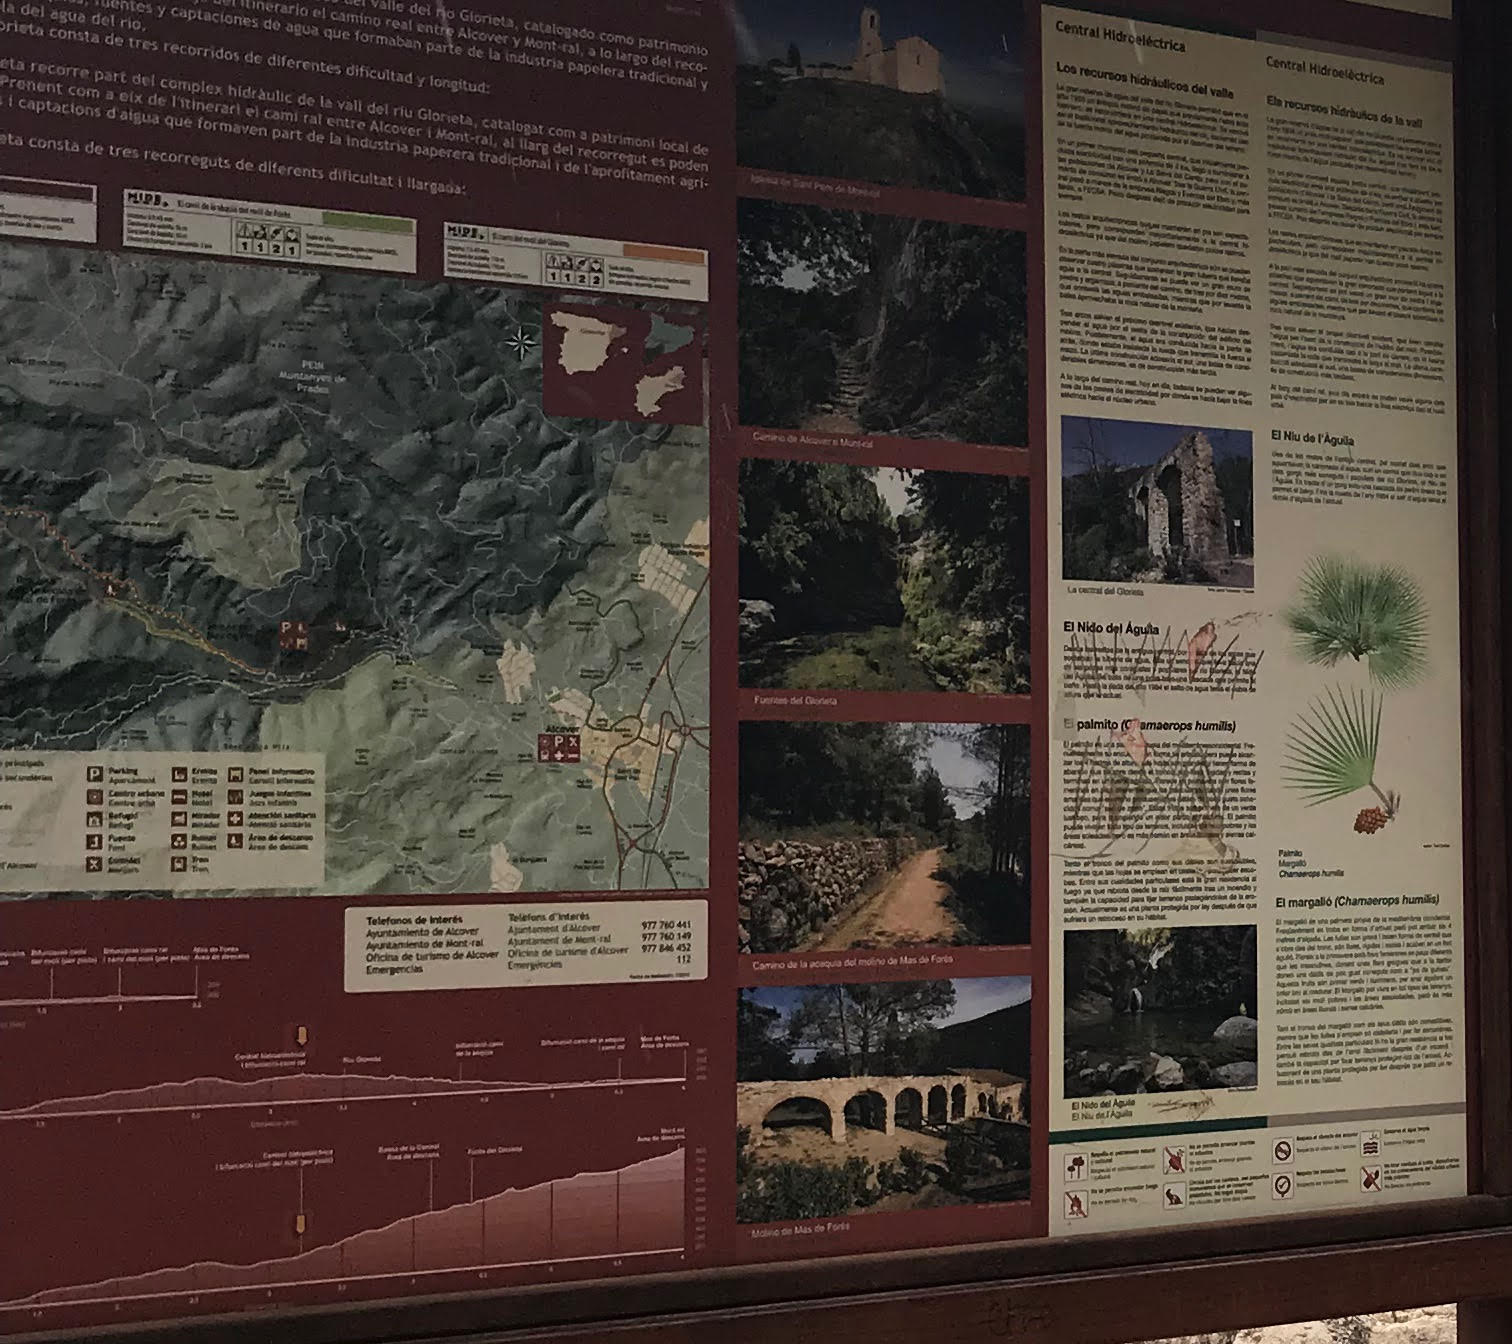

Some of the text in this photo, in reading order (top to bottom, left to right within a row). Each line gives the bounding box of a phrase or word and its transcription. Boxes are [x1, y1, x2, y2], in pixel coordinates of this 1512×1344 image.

[410, 1, 430, 16] del
[460, 9, 516, 31] Glorieta,
[524, 21, 594, 41] catalogado
[600, 32, 633, 46] como
[639, 38, 707, 57] patrimonio
[313, 6, 325, 18] el
[330, 10, 380, 26] camino
[386, 18, 411, 31] real
[417, 22, 453, 36] entre
[458, 25, 507, 44] Alcover
[513, 36, 520, 50] y
[525, 35, 583, 57] Mont-ral,
[589, 47, 595, 57] a
[616, 48, 647, 67] largo
[652, 53, 670, 68] del
[675, 59, 706, 72] reco-
[1056, 20, 1186, 53] Central Hidroeléctrica
[158, 5, 164, 19] y
[171, 7, 257, 27] captaciones
[264, 16, 280, 30] de
[286, 22, 318, 37] agua
[324, 27, 349, 42] que
[355, 29, 420, 50] formaban
[426, 41, 461, 55] parte
[468, 44, 482, 58] de
[489, 47, 500, 60] la
[506, 50, 563, 69] industria
[568, 61, 624, 77] papelera
[629, 67, 696, 87] tradicional
[701, 79, 707, 93] y
[50, 29, 98, 44] consta
[105, 33, 122, 48] de
[129, 38, 157, 52] tres
[164, 44, 238, 63] recorridos
[244, 51, 260, 65] de
[268, 54, 340, 75] diferentes
[346, 64, 412, 84] dificultad
[418, 76, 424, 90] y
[430, 74, 488, 94] longitud:
[1266, 56, 1306, 73] Central
[1057, 61, 1234, 99] Los recursos hidráulicos del valle
[31, 63, 88, 79] recorre
[95, 71, 125, 85] part
[132, 72, 154, 87] del
[160, 79, 221, 96] complex
[298, 92, 314, 106] de
[320, 95, 331, 108] la
[338, 99, 361, 112] vall
[367, 101, 387, 115] del
[394, 106, 412, 118] riu
[418, 107, 476, 128] Glorieta,
[483, 118, 542, 137] catalogat
[548, 126, 575, 139] com
[580, 130, 586, 140] a
[592, 132, 654, 148] patrimoni
[659, 137, 688, 153] local
[693, 141, 708, 155] de
[1267, 95, 1282, 106] Els
[1285, 100, 1328, 115] recursos
[1380, 113, 1393, 124] de
[1395, 115, 1404, 126] la
[1272, 429, 1281, 440] El
[1284, 431, 1300, 442] Niu
[1303, 432, 1316, 443] de
[1064, 621, 1074, 632] El
[1077, 622, 1103, 633] Nido
[1106, 621, 1122, 634] del
[1077, 719, 1118, 732] palmito
[1121, 719, 1193, 732] (Camaerops
[1195, 721, 1236, 733] humilis)
[1276, 897, 1285, 908] El
[1334, 895, 1399, 909] (Chamaerops
[1402, 893, 1440, 906] humilis)
[415, 914, 426, 923] de
[642, 920, 656, 929] 977
[366, 926, 478, 939] Ayuntamiento de Alcover
[642, 932, 656, 941] 977
[678, 931, 691, 940] 149
[366, 937, 483, 950] Ayuntamiento de Mont-ral
[642, 944, 656, 953] 977
[402, 951, 412, 959] de
[416, 951, 449, 959] turismo
[452, 950, 463, 959] de
[466, 950, 498, 958] Alcover
[678, 955, 690, 964] 112
